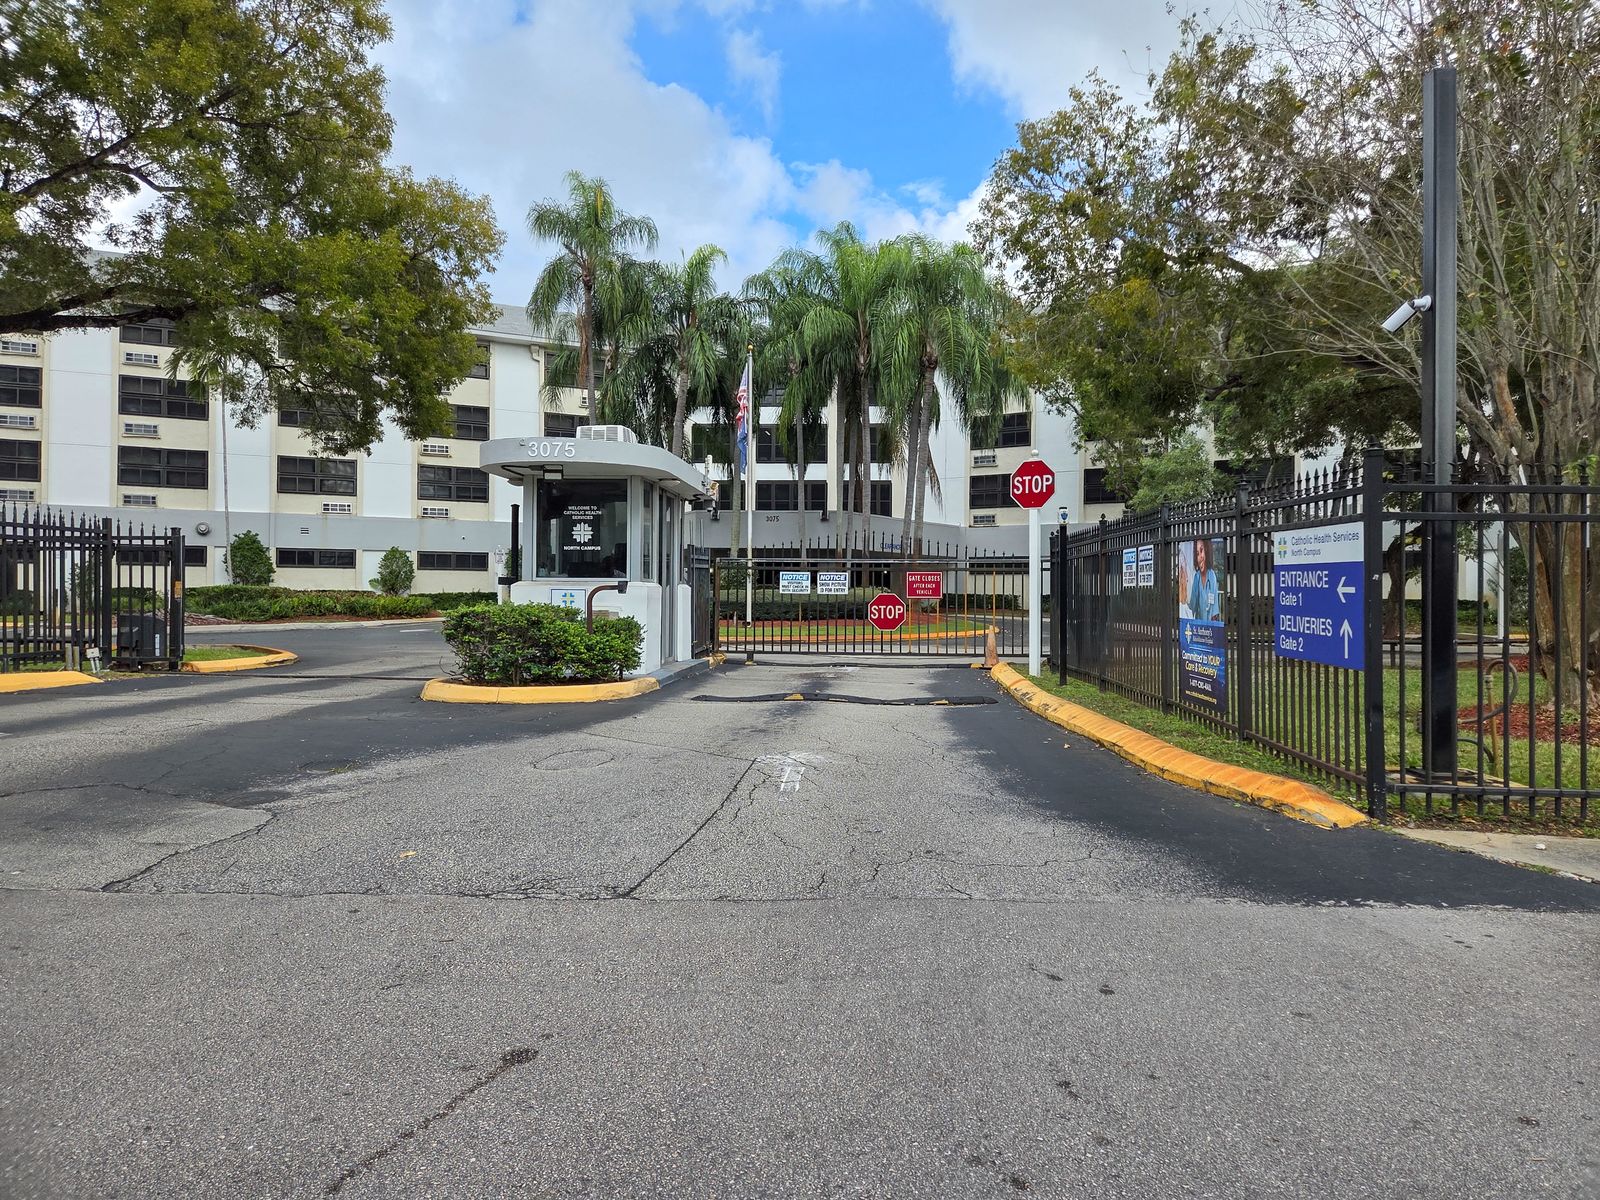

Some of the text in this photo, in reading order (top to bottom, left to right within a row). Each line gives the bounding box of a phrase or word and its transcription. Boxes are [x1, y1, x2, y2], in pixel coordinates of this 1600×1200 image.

[527, 441, 576, 458] 3075
[1013, 474, 1053, 495] STOP
[766, 515, 780, 523] 3075
[1291, 531, 1360, 546] Catholic Health Services
[1291, 547, 1322, 557] North Campus
[1280, 570, 1329, 588] ENTRANCE
[1280, 590, 1302, 607] Gate 1
[870, 605, 903, 619] STOP
[1280, 614, 1333, 637] DELIVERIES
[1280, 634, 1304, 652] Gate 2
[1182, 650, 1220, 667] Committed to YOUR
[1185, 660, 1195, 671] Care
[1199, 663, 1217, 679] Recovery
